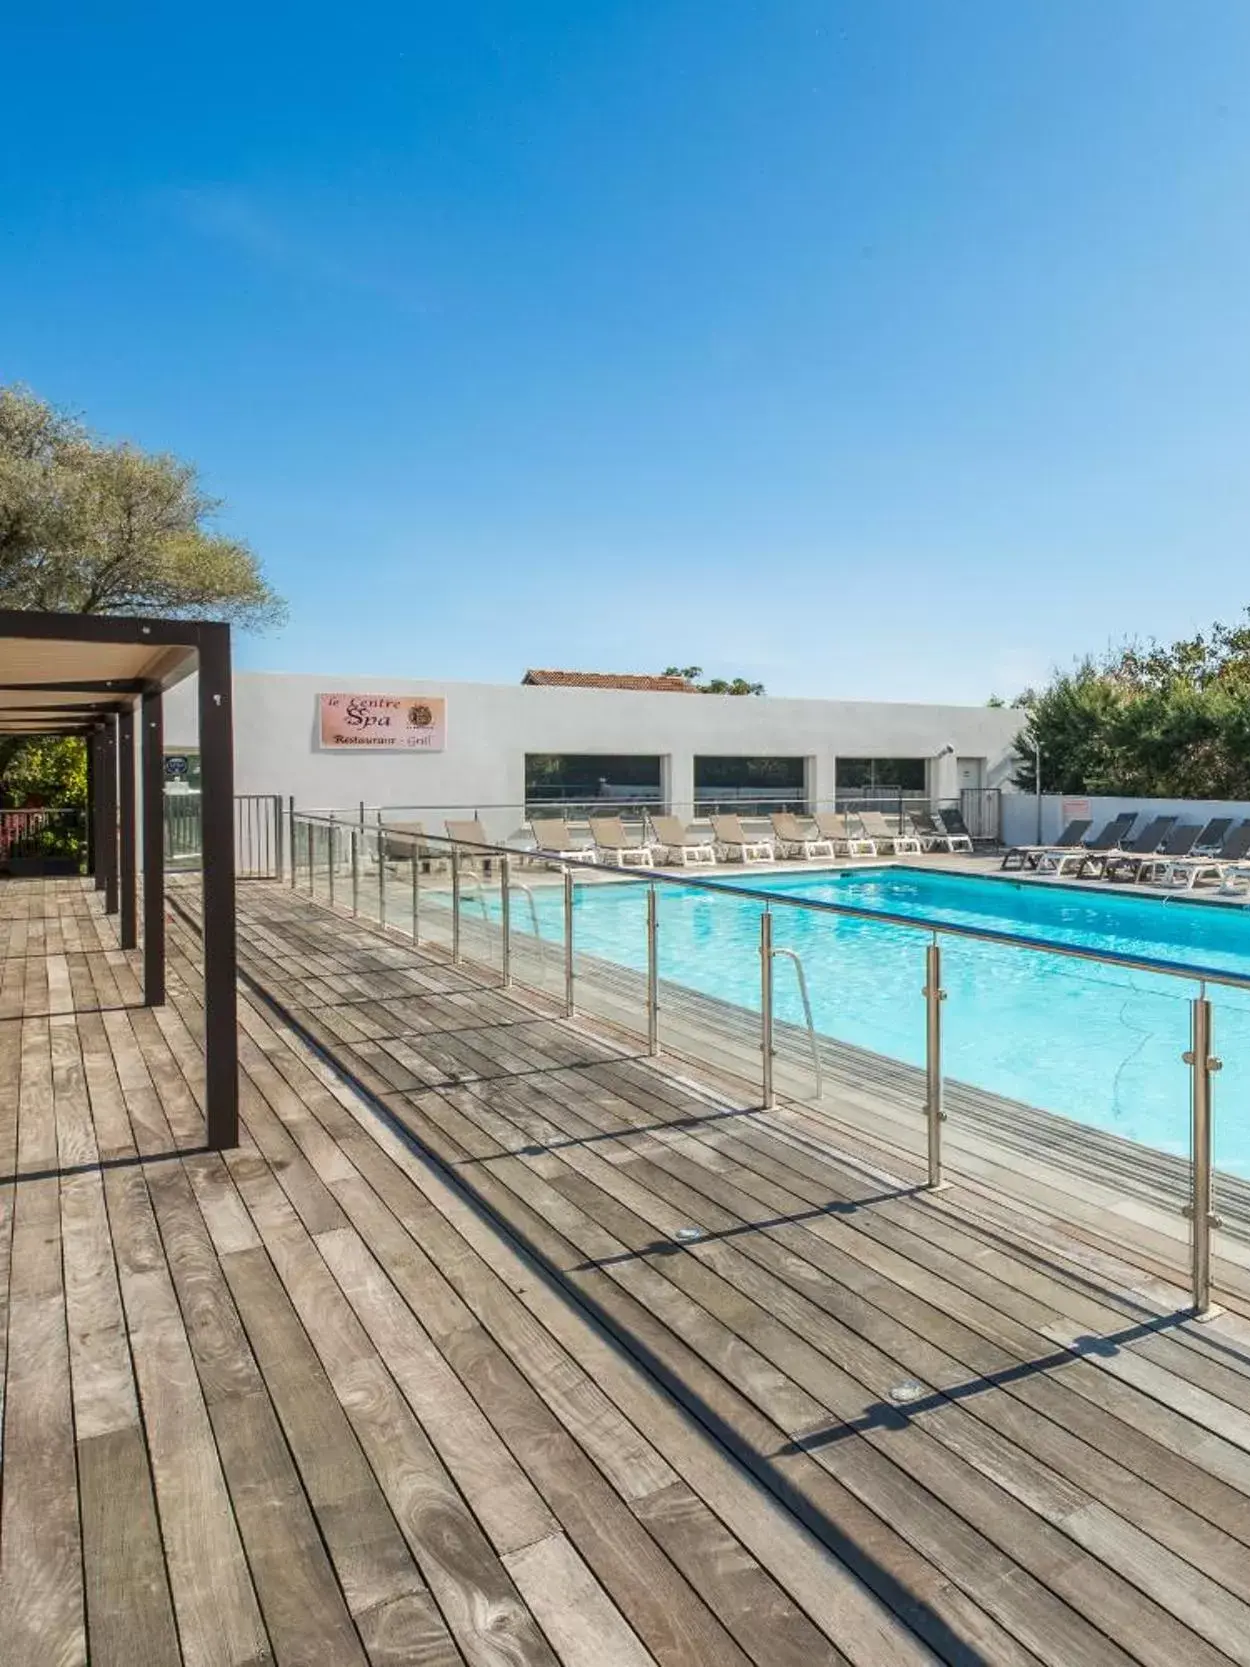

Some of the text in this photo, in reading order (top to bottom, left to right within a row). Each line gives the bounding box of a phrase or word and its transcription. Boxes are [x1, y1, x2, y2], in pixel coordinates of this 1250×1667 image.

[349, 698, 400, 709] Centre
[344, 706, 390, 730] Spa
[333, 735, 395, 745] Restaurant
[406, 735, 431, 747] Grill
